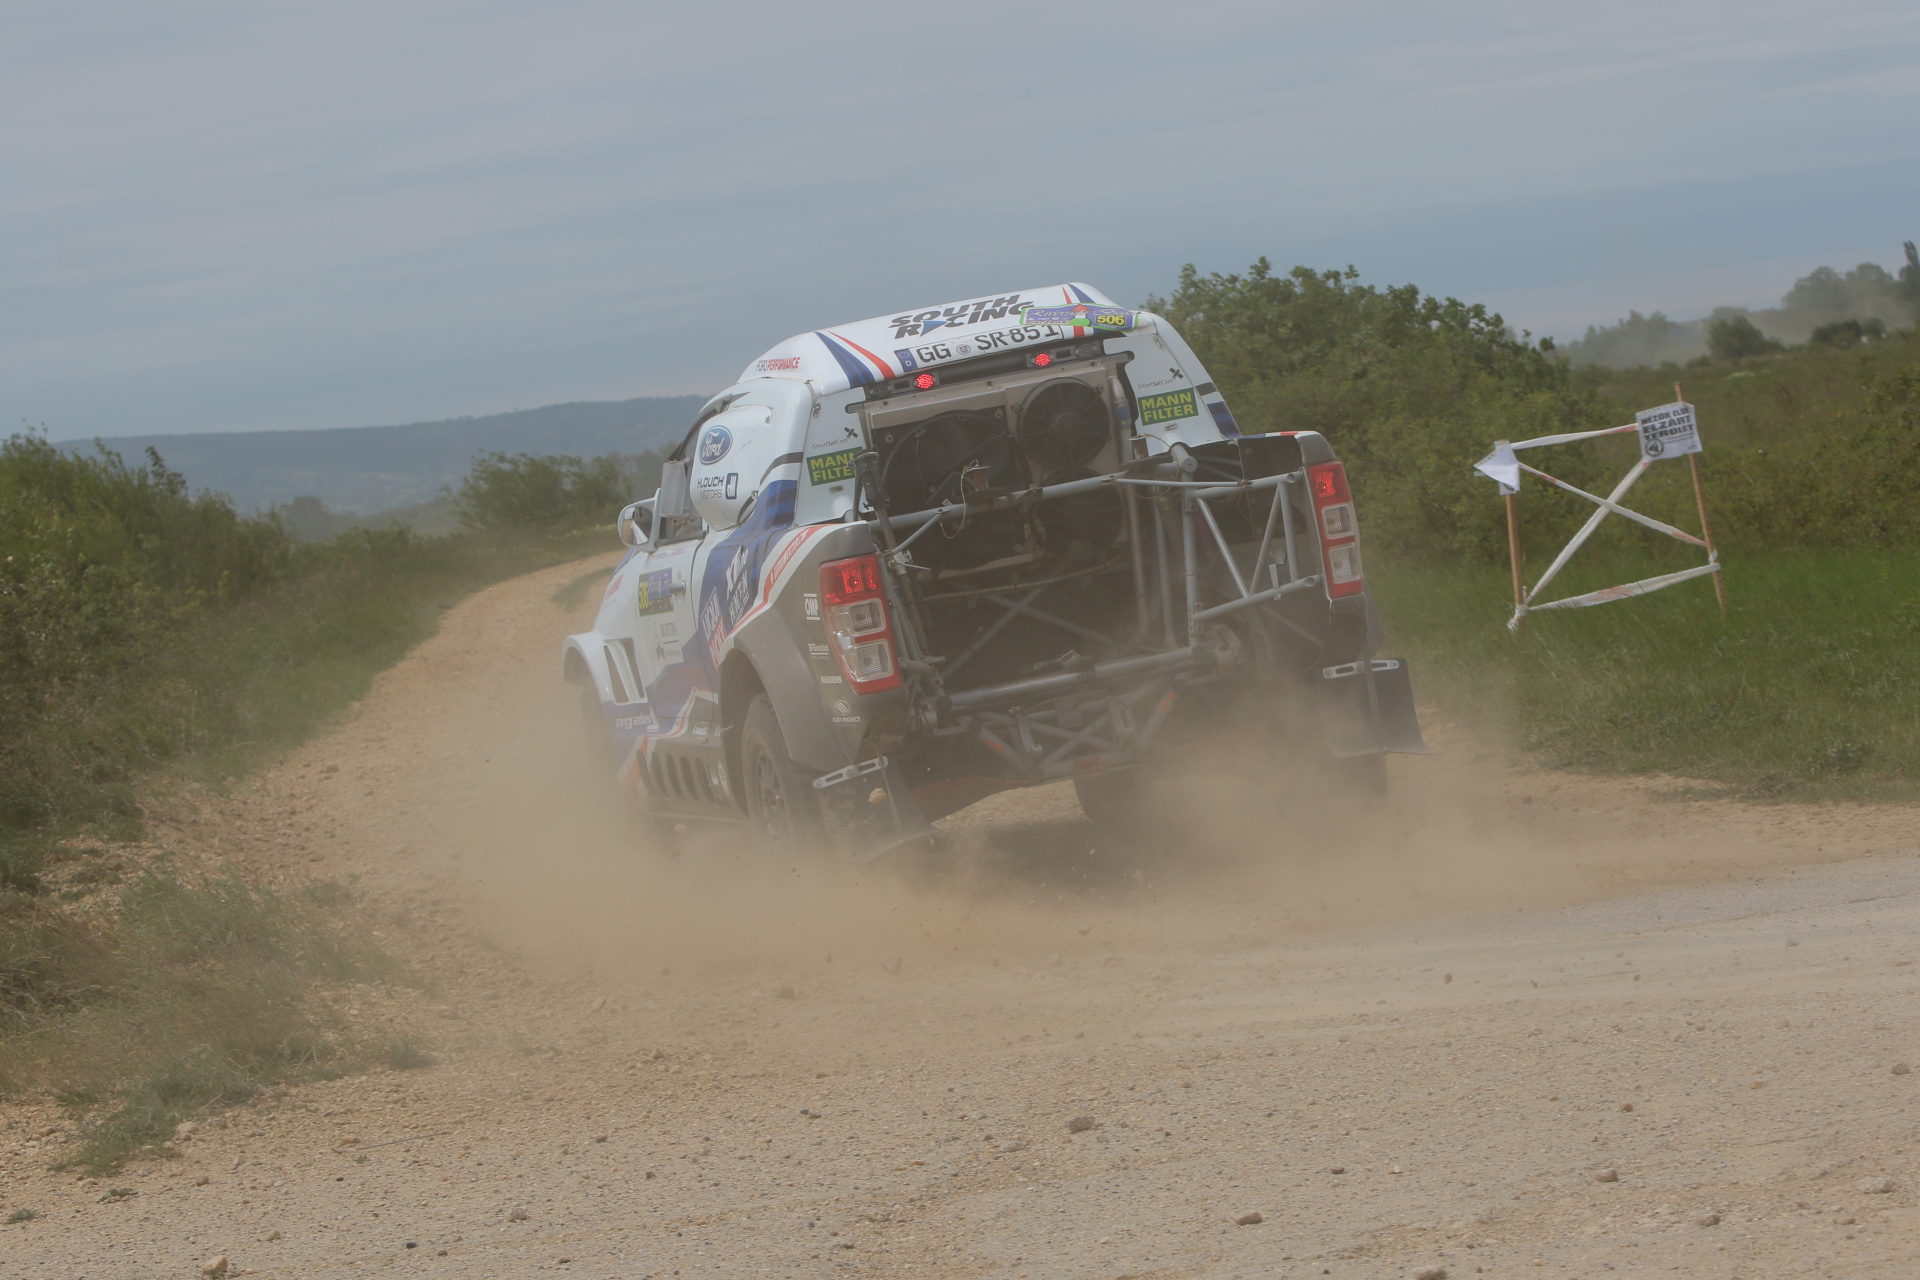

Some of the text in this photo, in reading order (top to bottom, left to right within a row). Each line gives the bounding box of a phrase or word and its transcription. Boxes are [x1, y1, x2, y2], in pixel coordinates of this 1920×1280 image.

[889, 294, 1021, 328] SOUTH
[1096, 315, 1125, 326] 506
[915, 343, 952, 363] GG
[1141, 392, 1192, 410] MANN
[1143, 404, 1195, 422] FILTER
[702, 432, 725, 458] Ford
[812, 466, 856, 482] FILTE
[804, 598, 819, 616] OMP
